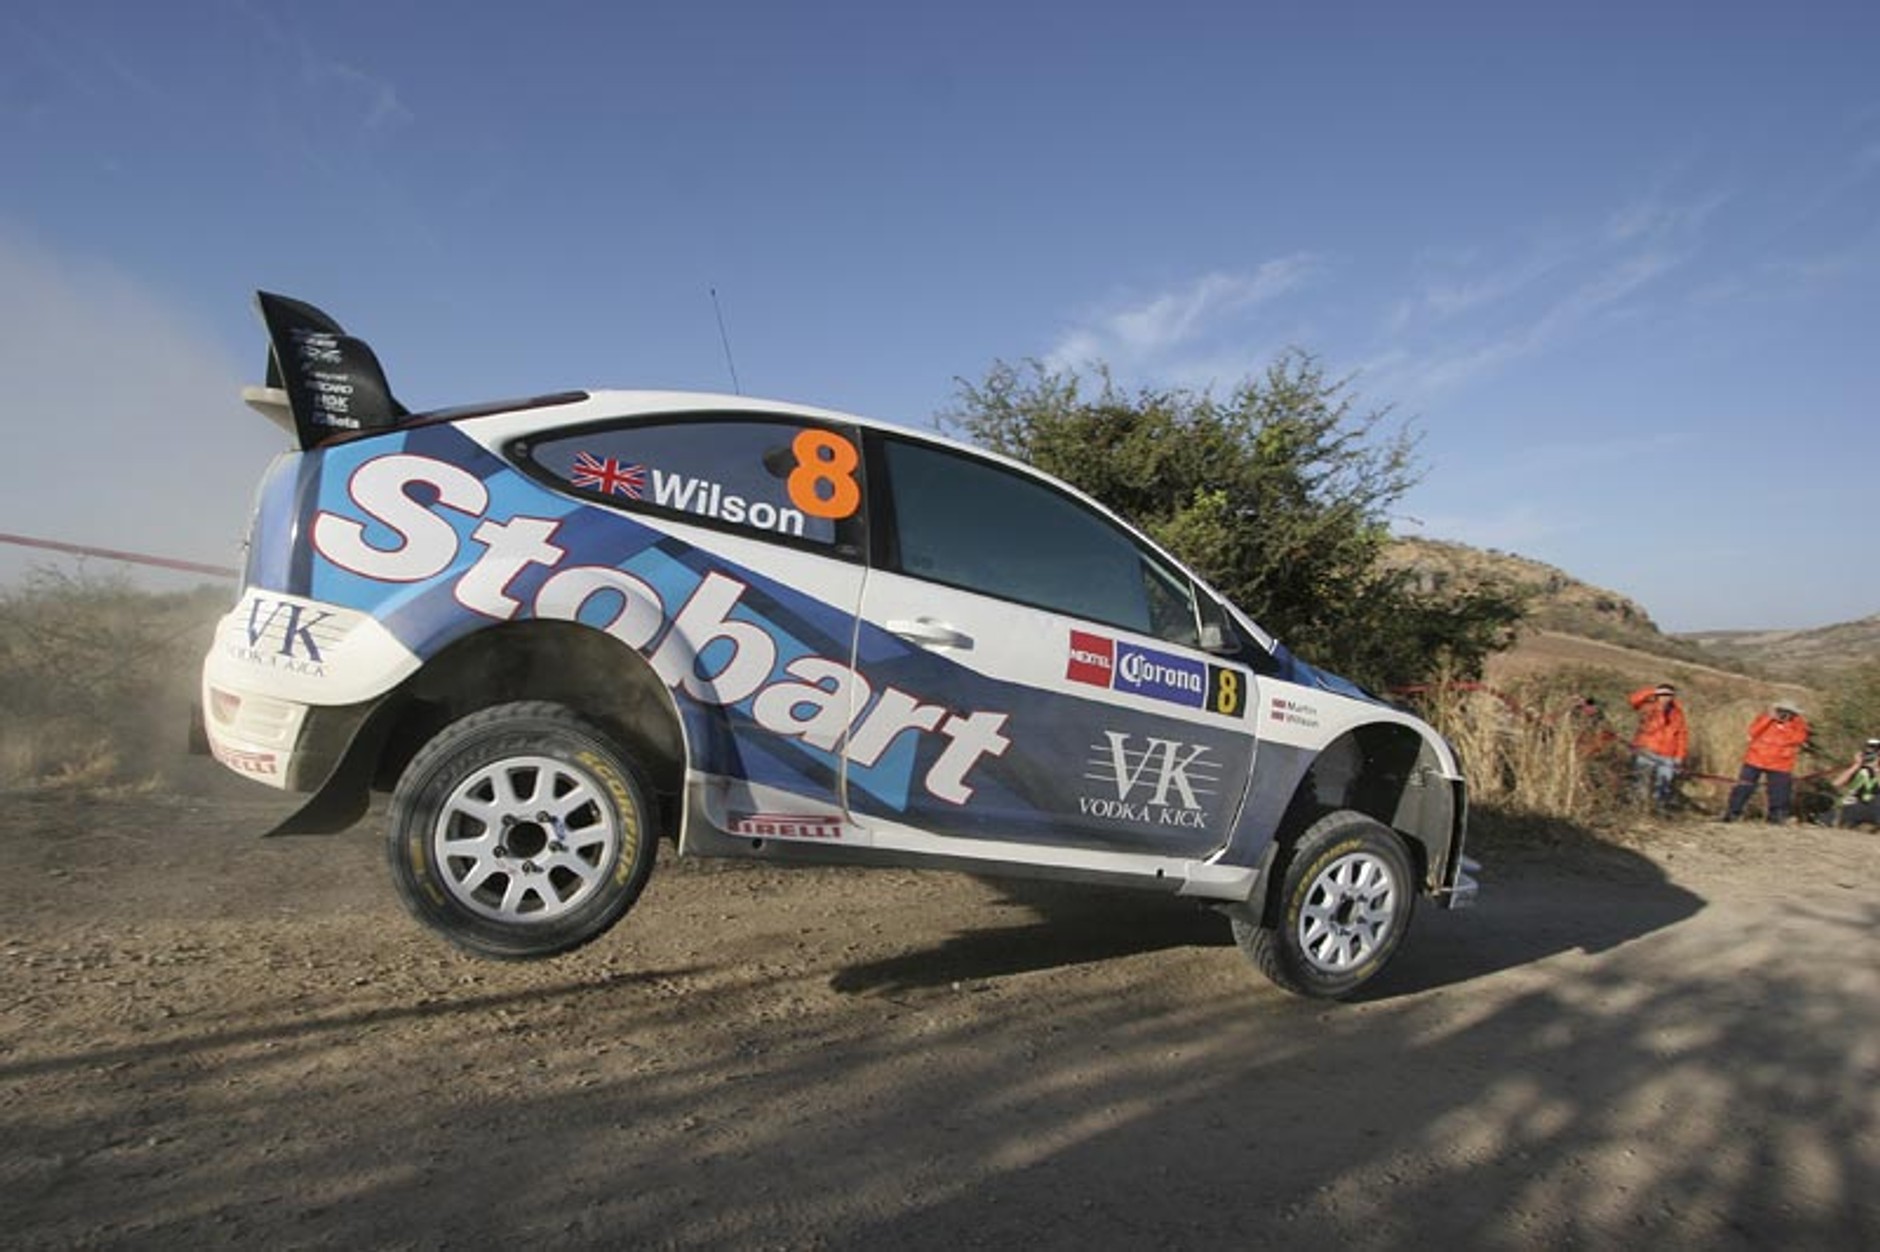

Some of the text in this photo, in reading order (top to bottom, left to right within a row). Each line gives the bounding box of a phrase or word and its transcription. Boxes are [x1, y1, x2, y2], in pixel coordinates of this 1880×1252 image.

[652, 468, 804, 536] Wilson
[788, 428, 861, 519] 8
[246, 598, 337, 663] VK
[310, 453, 1012, 805] Stobart
[1119, 651, 1202, 692] Corona
[1217, 668, 1238, 714] 8
[1104, 730, 1212, 810] VK
[727, 811, 843, 838] PIRELLI
[1079, 797, 1208, 829] VODKA KICK
